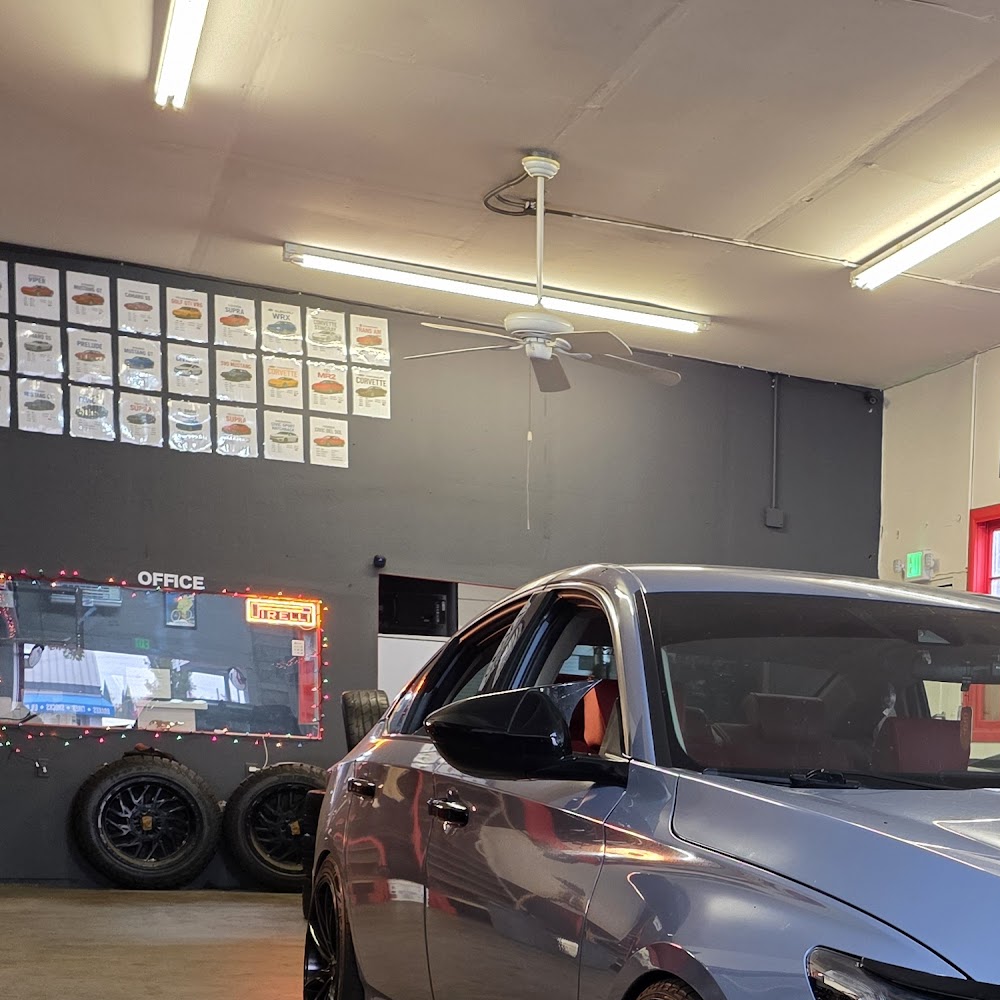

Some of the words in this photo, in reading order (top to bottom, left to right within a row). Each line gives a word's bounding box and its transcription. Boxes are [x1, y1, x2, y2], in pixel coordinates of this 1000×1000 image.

[225, 307, 245, 315] SUPRA
[272, 313, 291, 321] WRX
[77, 341, 102, 350] PRELUDE
[230, 362, 252, 370] MUSTANG
[267, 367, 298, 378] CORVETTE
[317, 372, 337, 380] MR2
[355, 376, 387, 388] CORVETTE
[130, 404, 152, 413] SUPRA
[225, 415, 246, 424] SUPRA
[137, 571, 205, 590] OFFICE
[250, 602, 313, 624] PIRELLI
